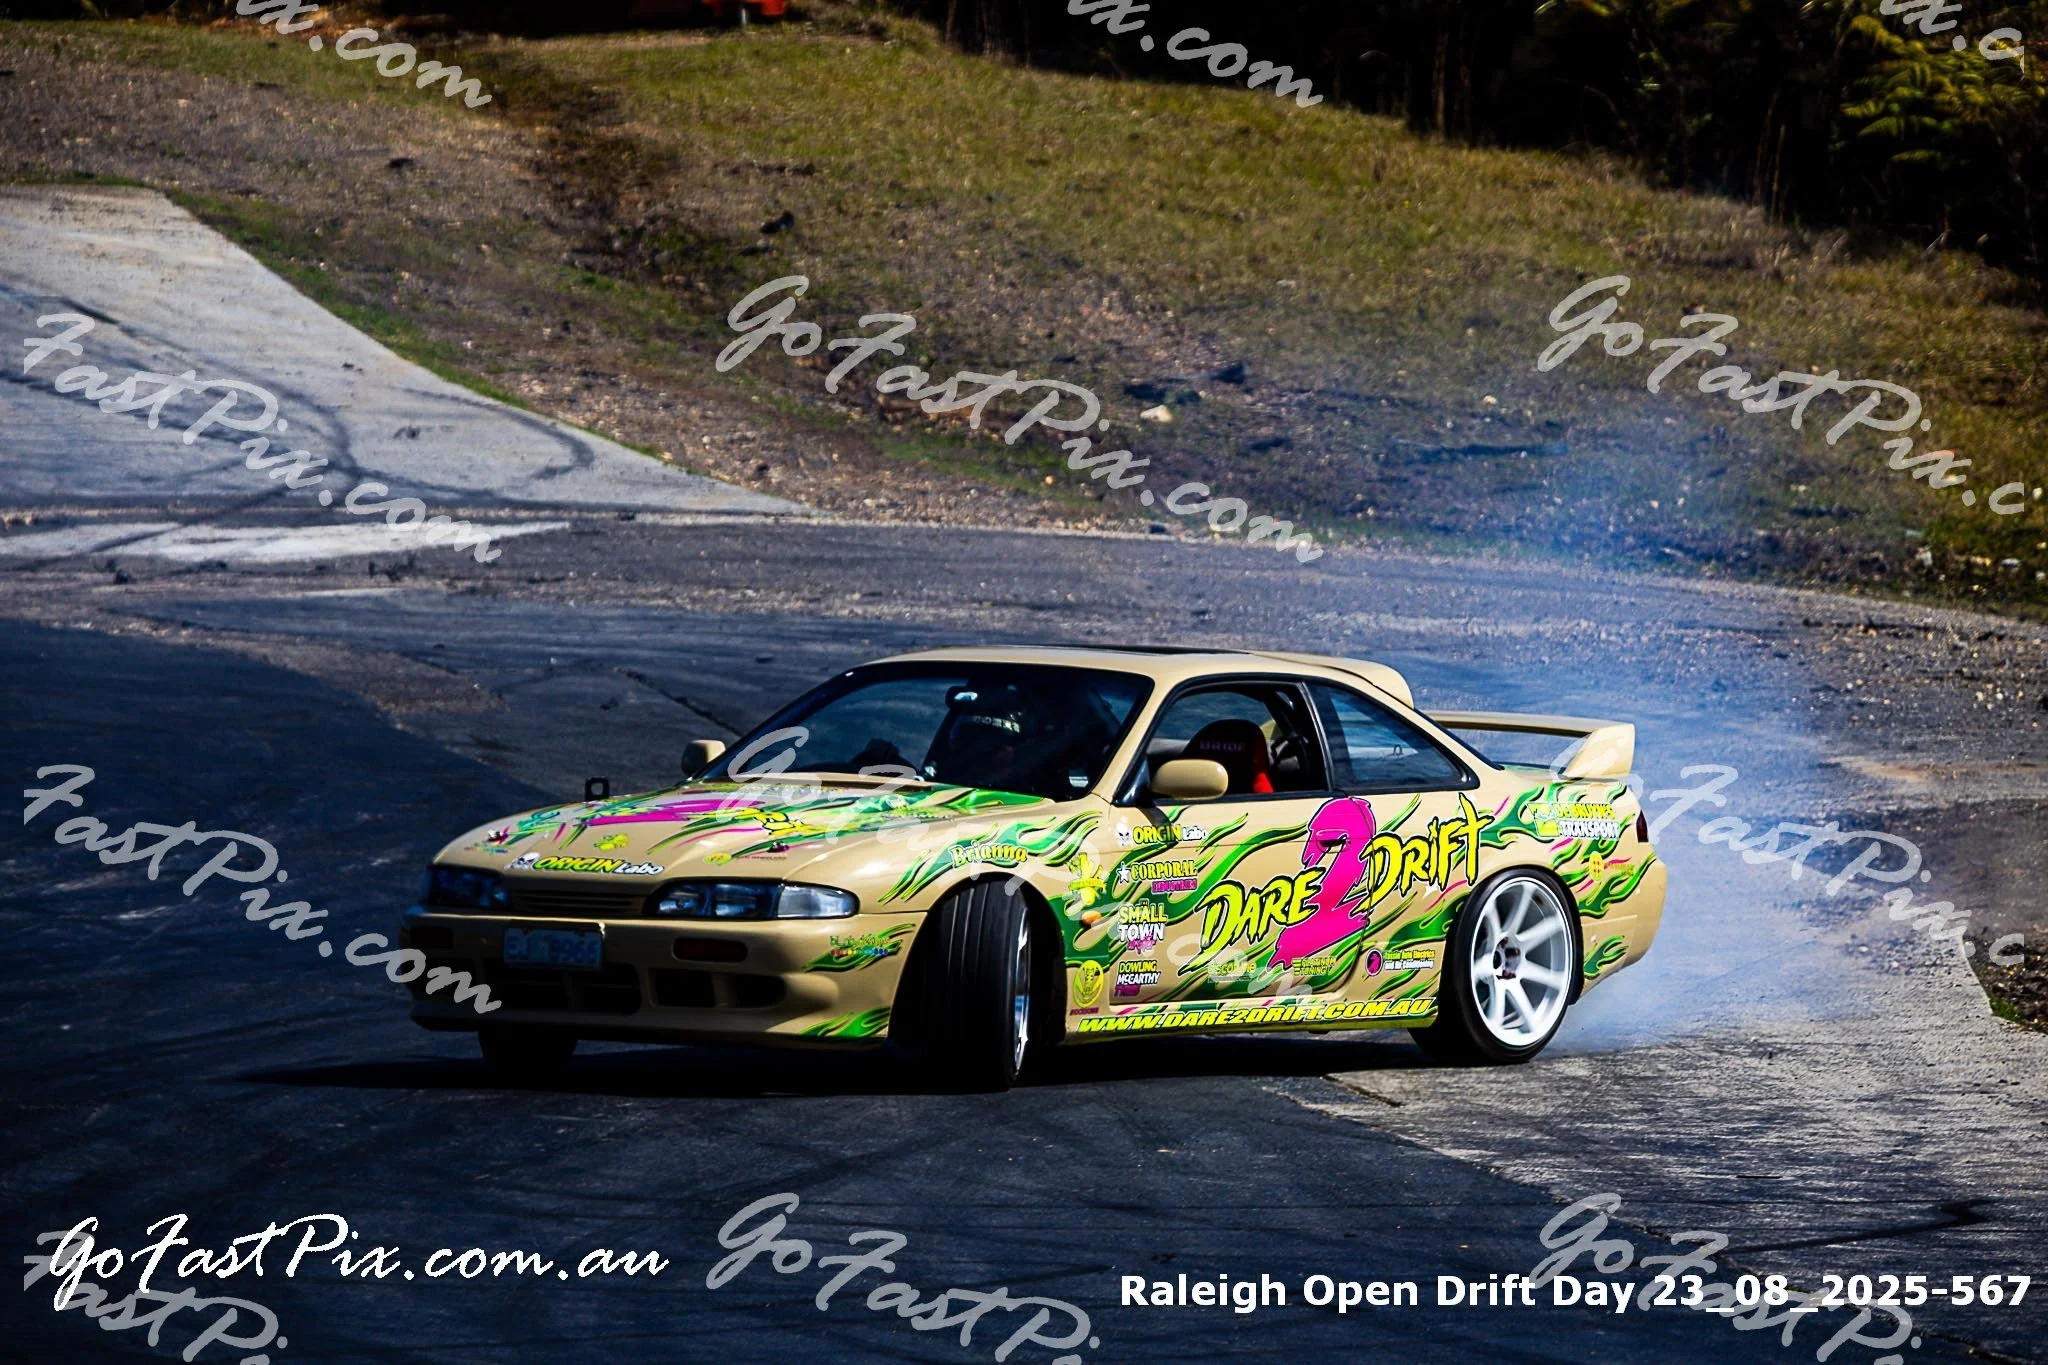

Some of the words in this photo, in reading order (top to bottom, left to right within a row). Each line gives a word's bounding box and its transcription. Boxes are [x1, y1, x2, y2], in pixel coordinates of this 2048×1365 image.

[1132, 824, 1182, 844] ORIGIN
[1559, 820, 1620, 839] TRANSPORT
[949, 839, 1029, 869] Brianna
[533, 856, 622, 874] ORIGIN
[1130, 860, 1198, 881] CORPORAL
[1177, 864, 1327, 976] DARE
[1265, 796, 1377, 970] 2
[1117, 922, 1166, 943] TOWN
[1119, 960, 1158, 975] DOWLING
[1077, 997, 1434, 1033] WWW.DARE2DRIFT.COM.AU
